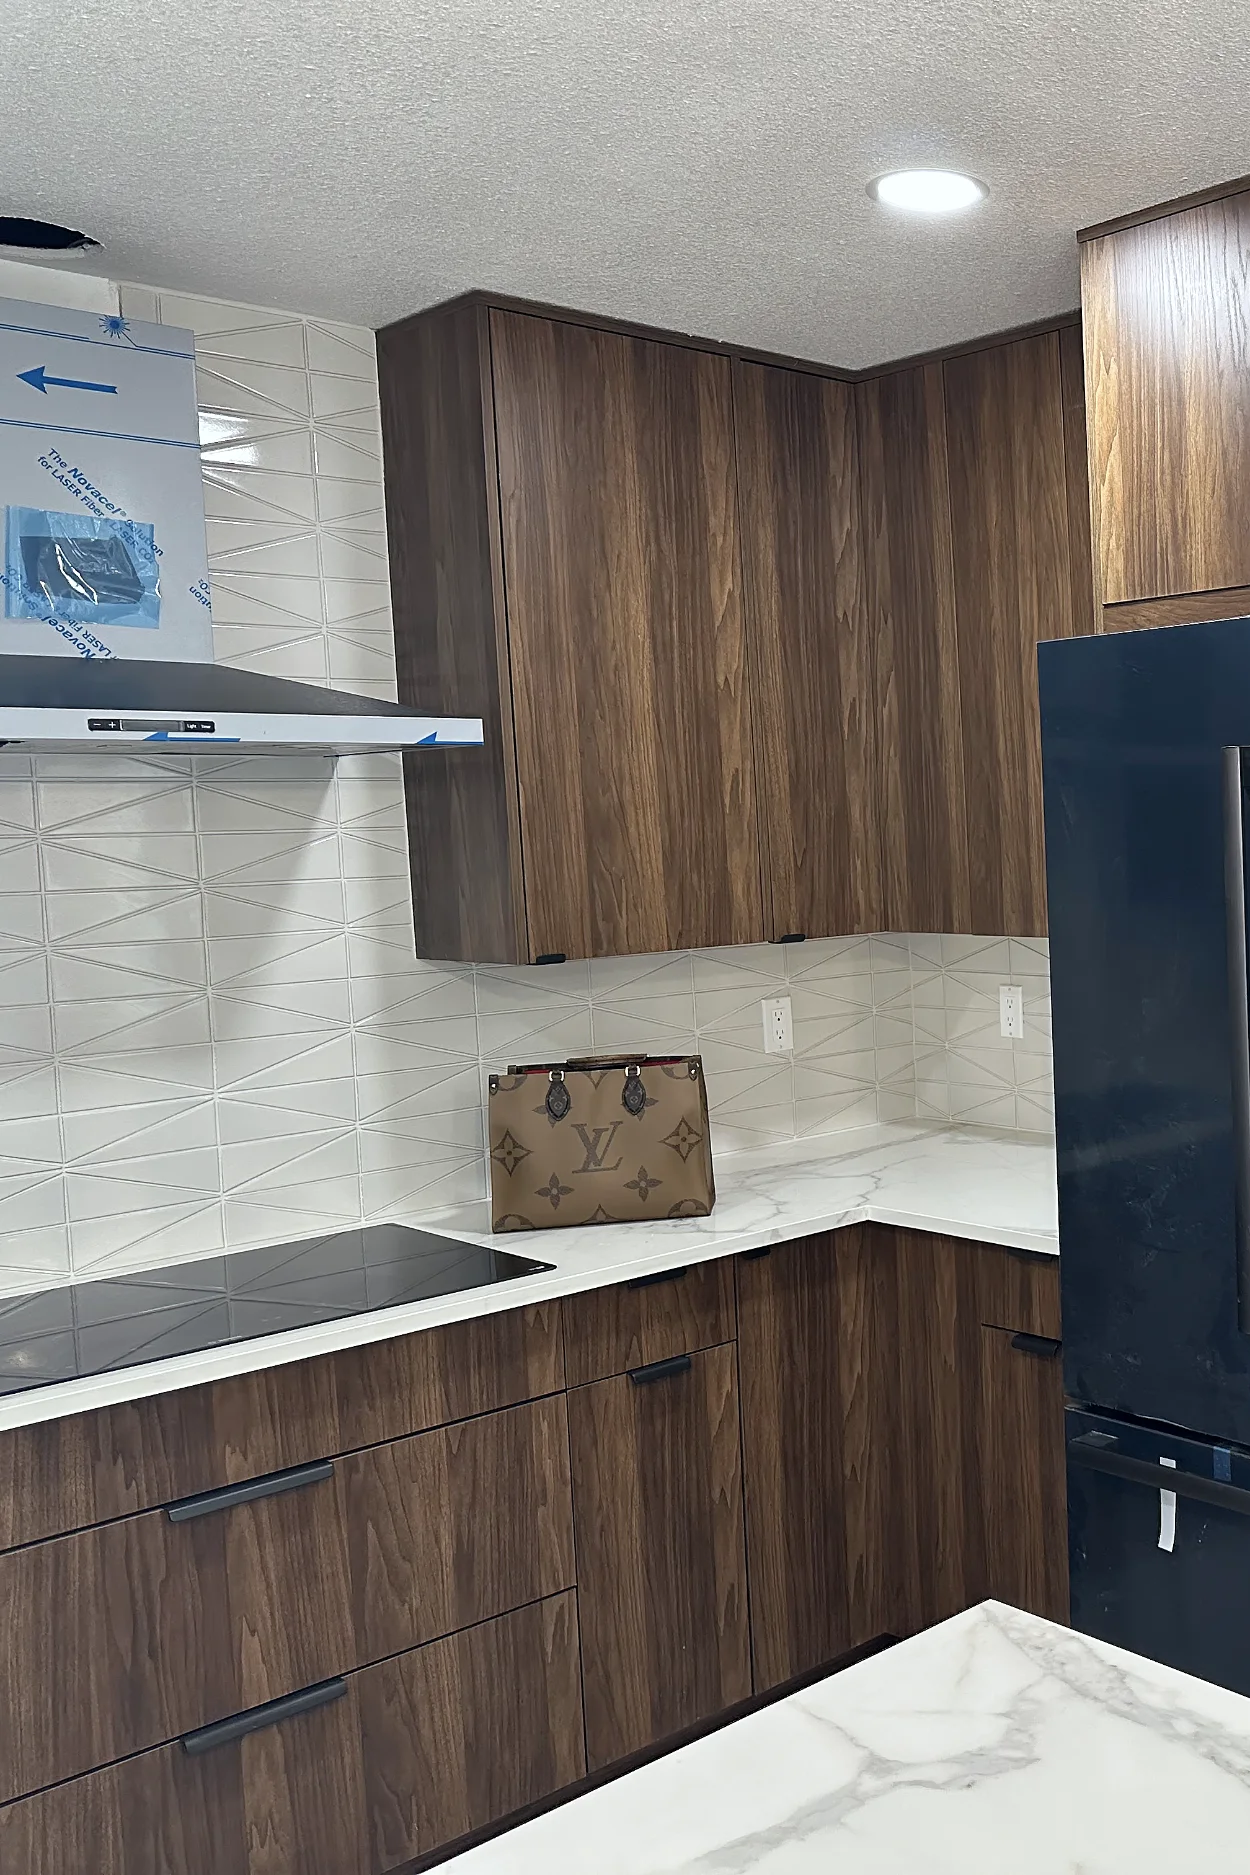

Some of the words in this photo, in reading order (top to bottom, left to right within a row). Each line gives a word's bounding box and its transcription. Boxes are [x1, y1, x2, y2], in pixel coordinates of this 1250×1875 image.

[38, 456, 53, 470] for
[51, 469, 82, 497] LASER
[81, 495, 105, 517] Fiber
[109, 522, 139, 549] LASER
[48, 448, 68, 468] The
[125, 519, 164, 556] Solution
[58, 611, 83, 632] Fiber
[82, 630, 112, 657] LASER
